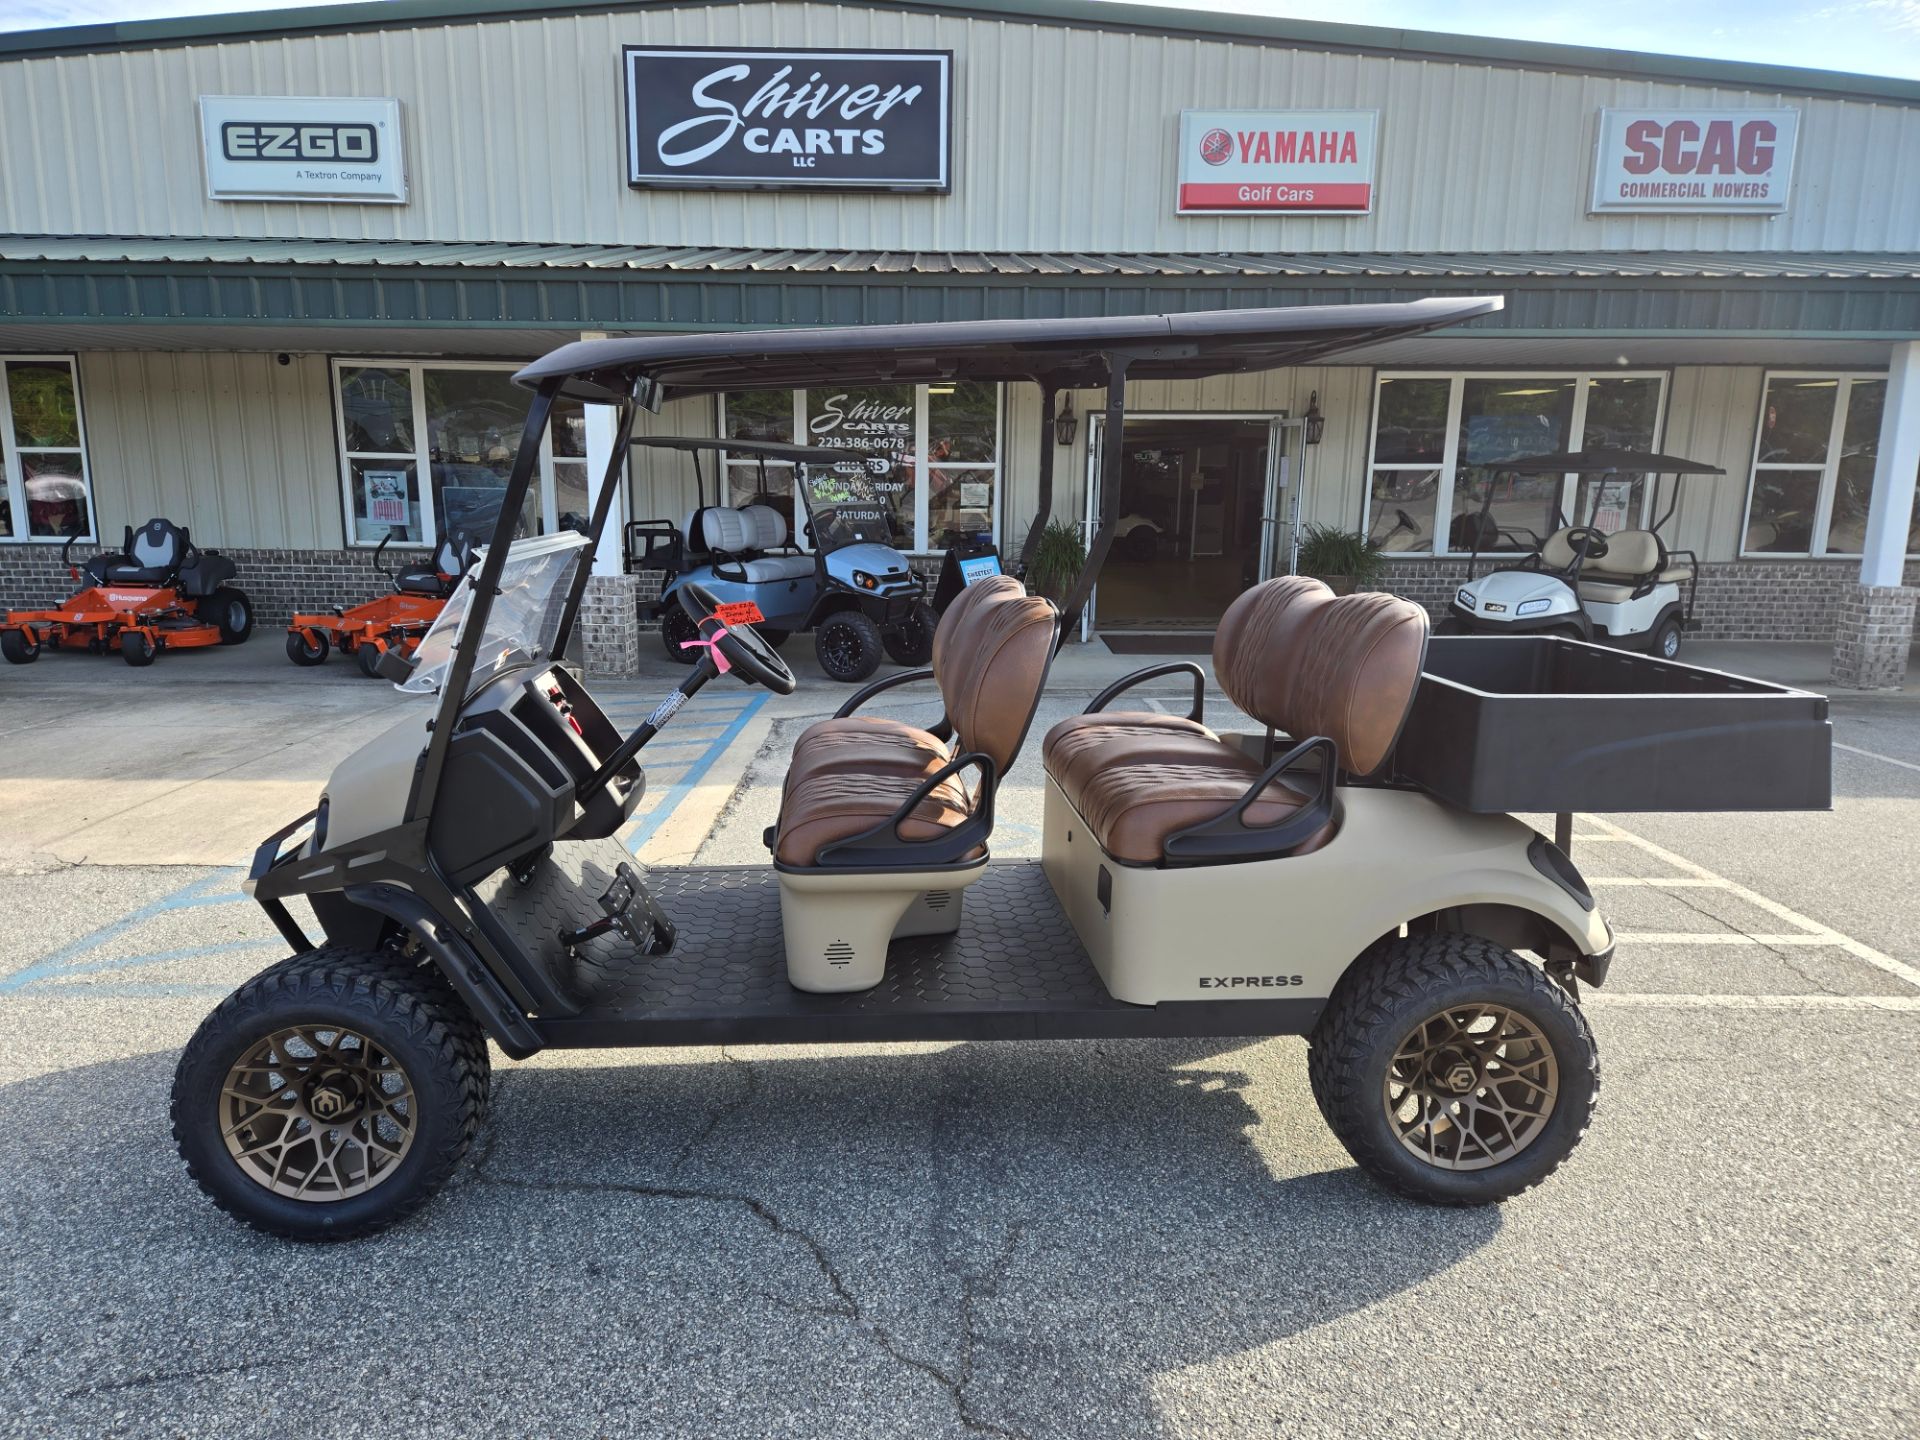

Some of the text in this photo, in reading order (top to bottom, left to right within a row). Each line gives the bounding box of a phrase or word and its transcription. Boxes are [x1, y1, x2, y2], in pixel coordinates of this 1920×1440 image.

[657, 63, 922, 167] Shiver
[226, 126, 373, 159] EZGO
[743, 128, 885, 155] CARTS
[1237, 131, 1358, 164] YAMAHA
[1623, 120, 1777, 175] SCAG
[793, 156, 816, 168] LLC
[304, 171, 338, 180] Textron
[340, 171, 382, 183] Company
[1238, 186, 1314, 201] Golf Cars
[1620, 182, 1769, 198] COMMERCIAL MOWERS
[810, 394, 913, 434] Shiver
[842, 422, 910, 431] CARTS
[818, 437, 905, 449] 229-386-0678
[836, 510, 887, 520] SATURDA
[1199, 975, 1304, 988] EXPRESS
